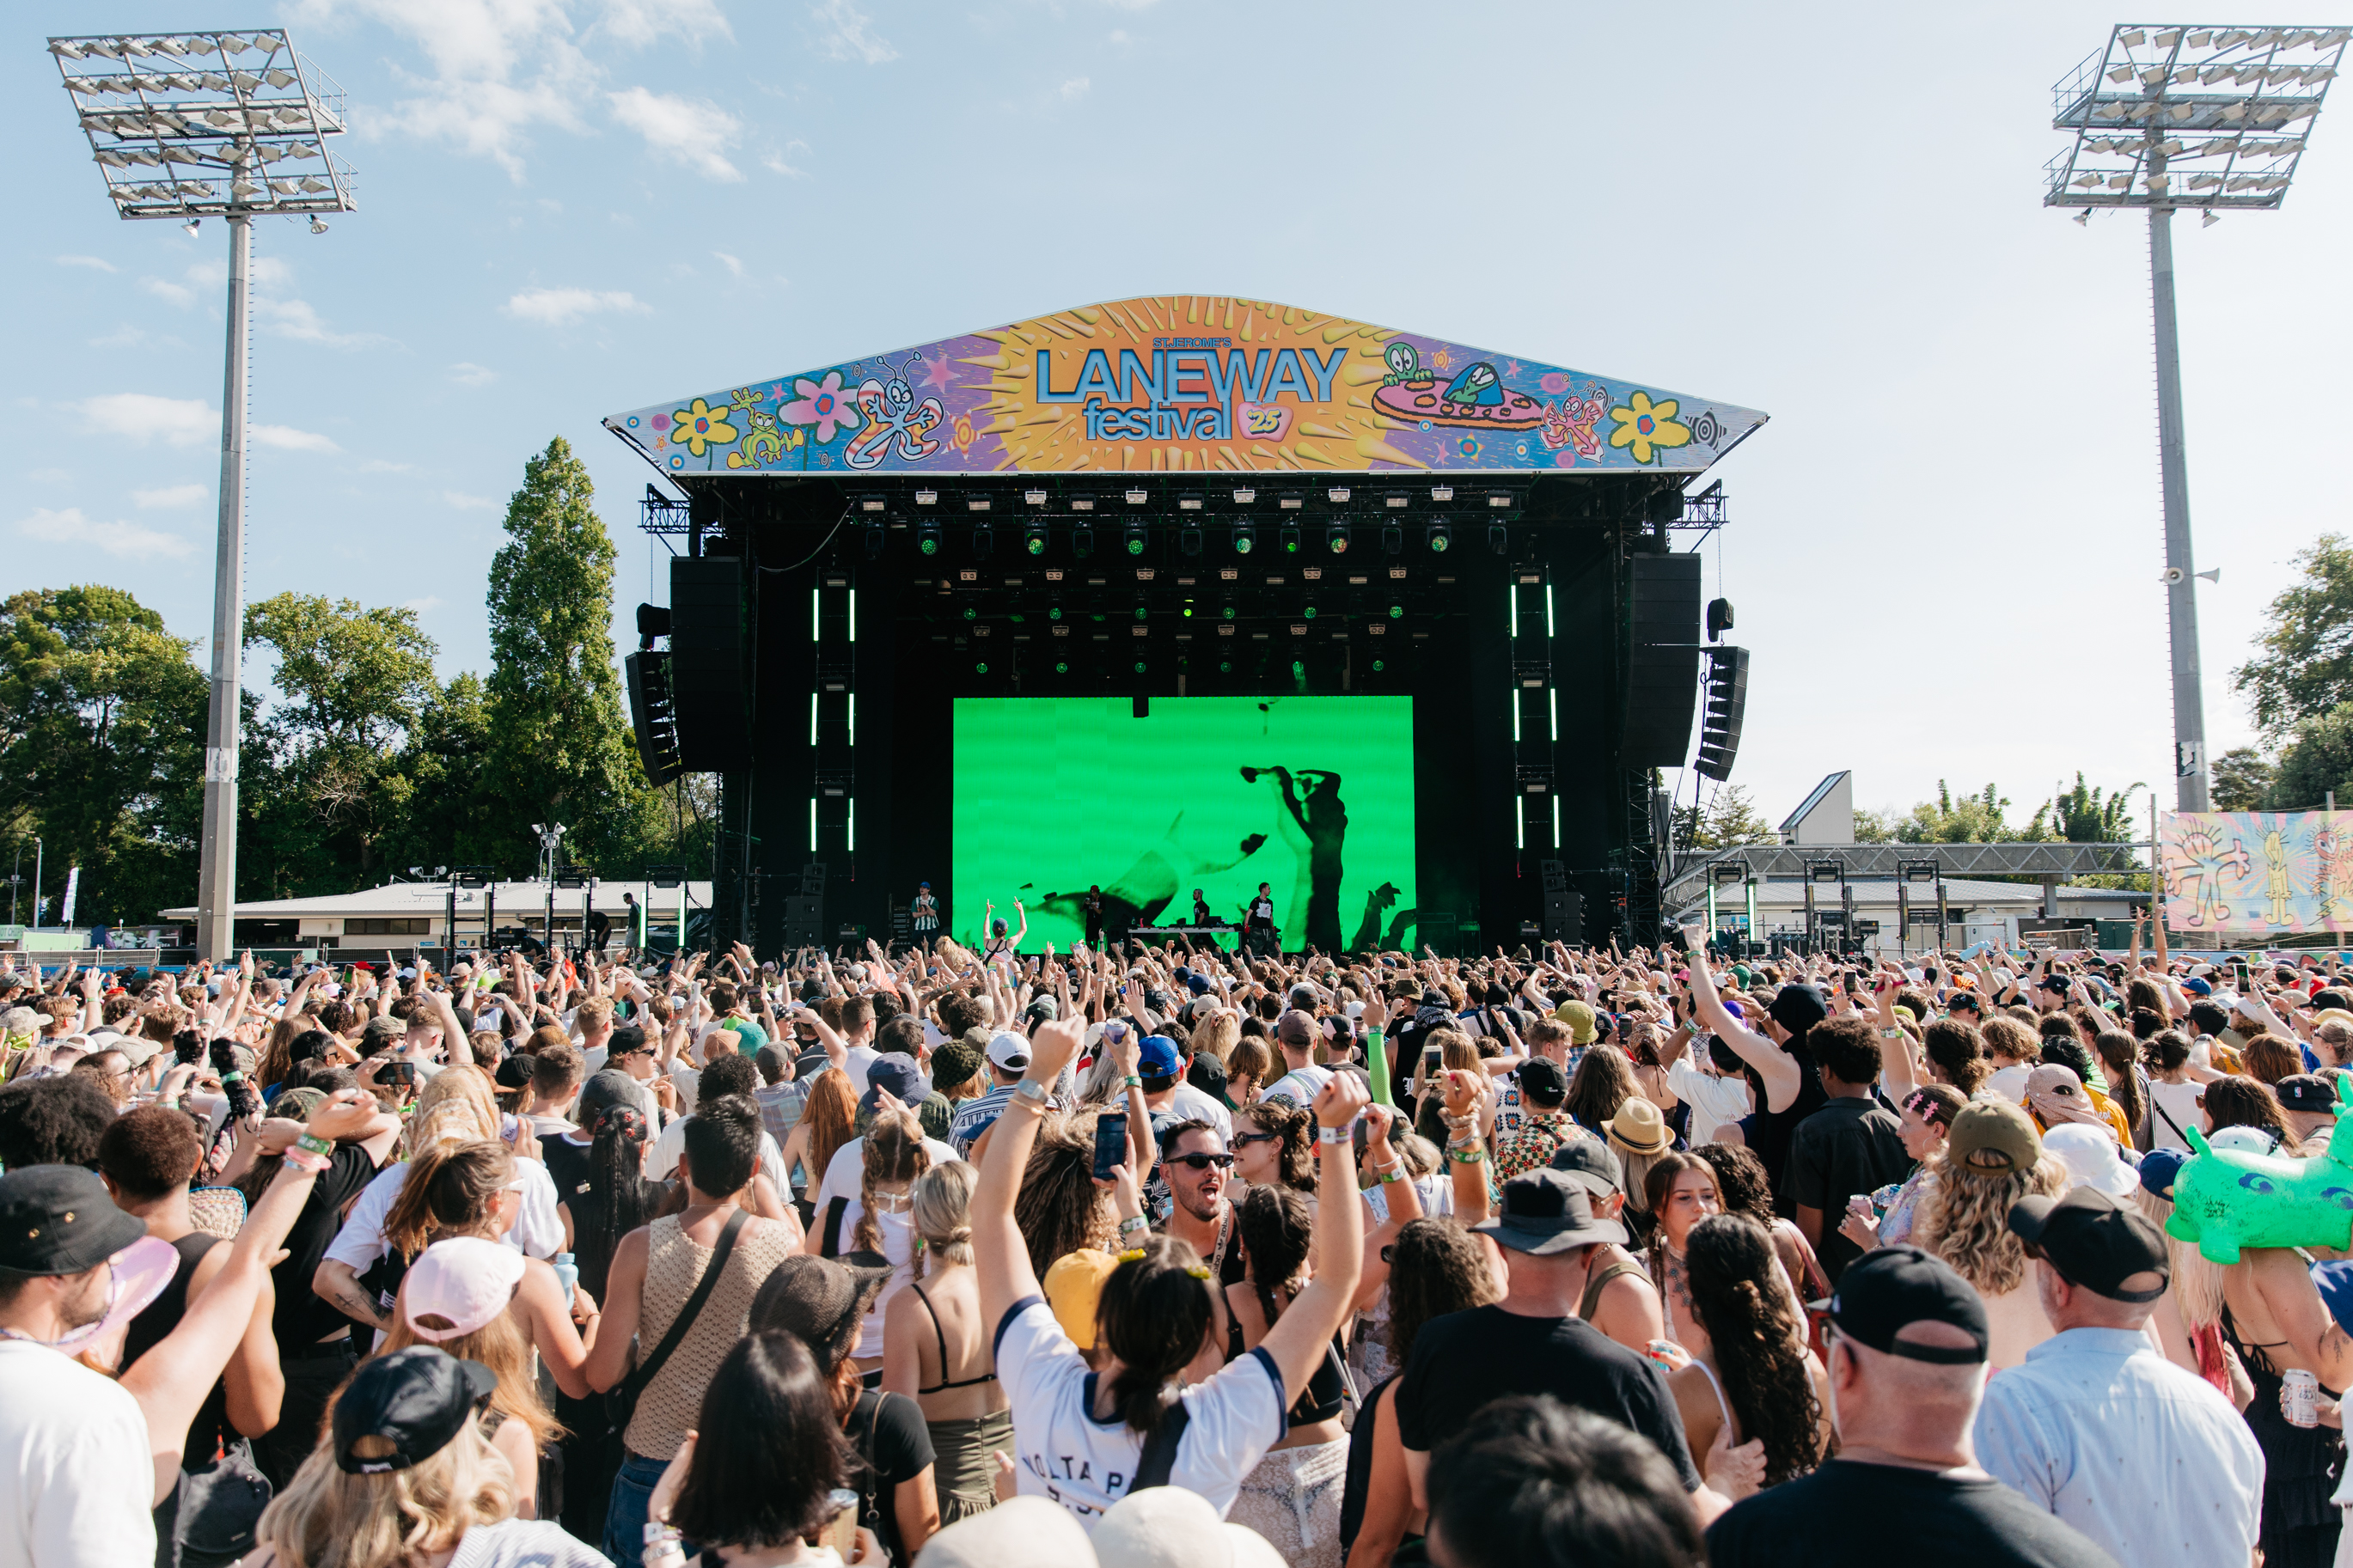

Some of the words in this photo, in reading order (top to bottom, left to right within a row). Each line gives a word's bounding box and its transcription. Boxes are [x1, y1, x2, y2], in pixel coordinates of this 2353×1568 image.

[1153, 338, 1232, 348] ST.JEROME'S
[1036, 348, 1349, 403] LANEWAY
[1083, 397, 1232, 441] festival
[1220, 1209, 1229, 1237] adidas
